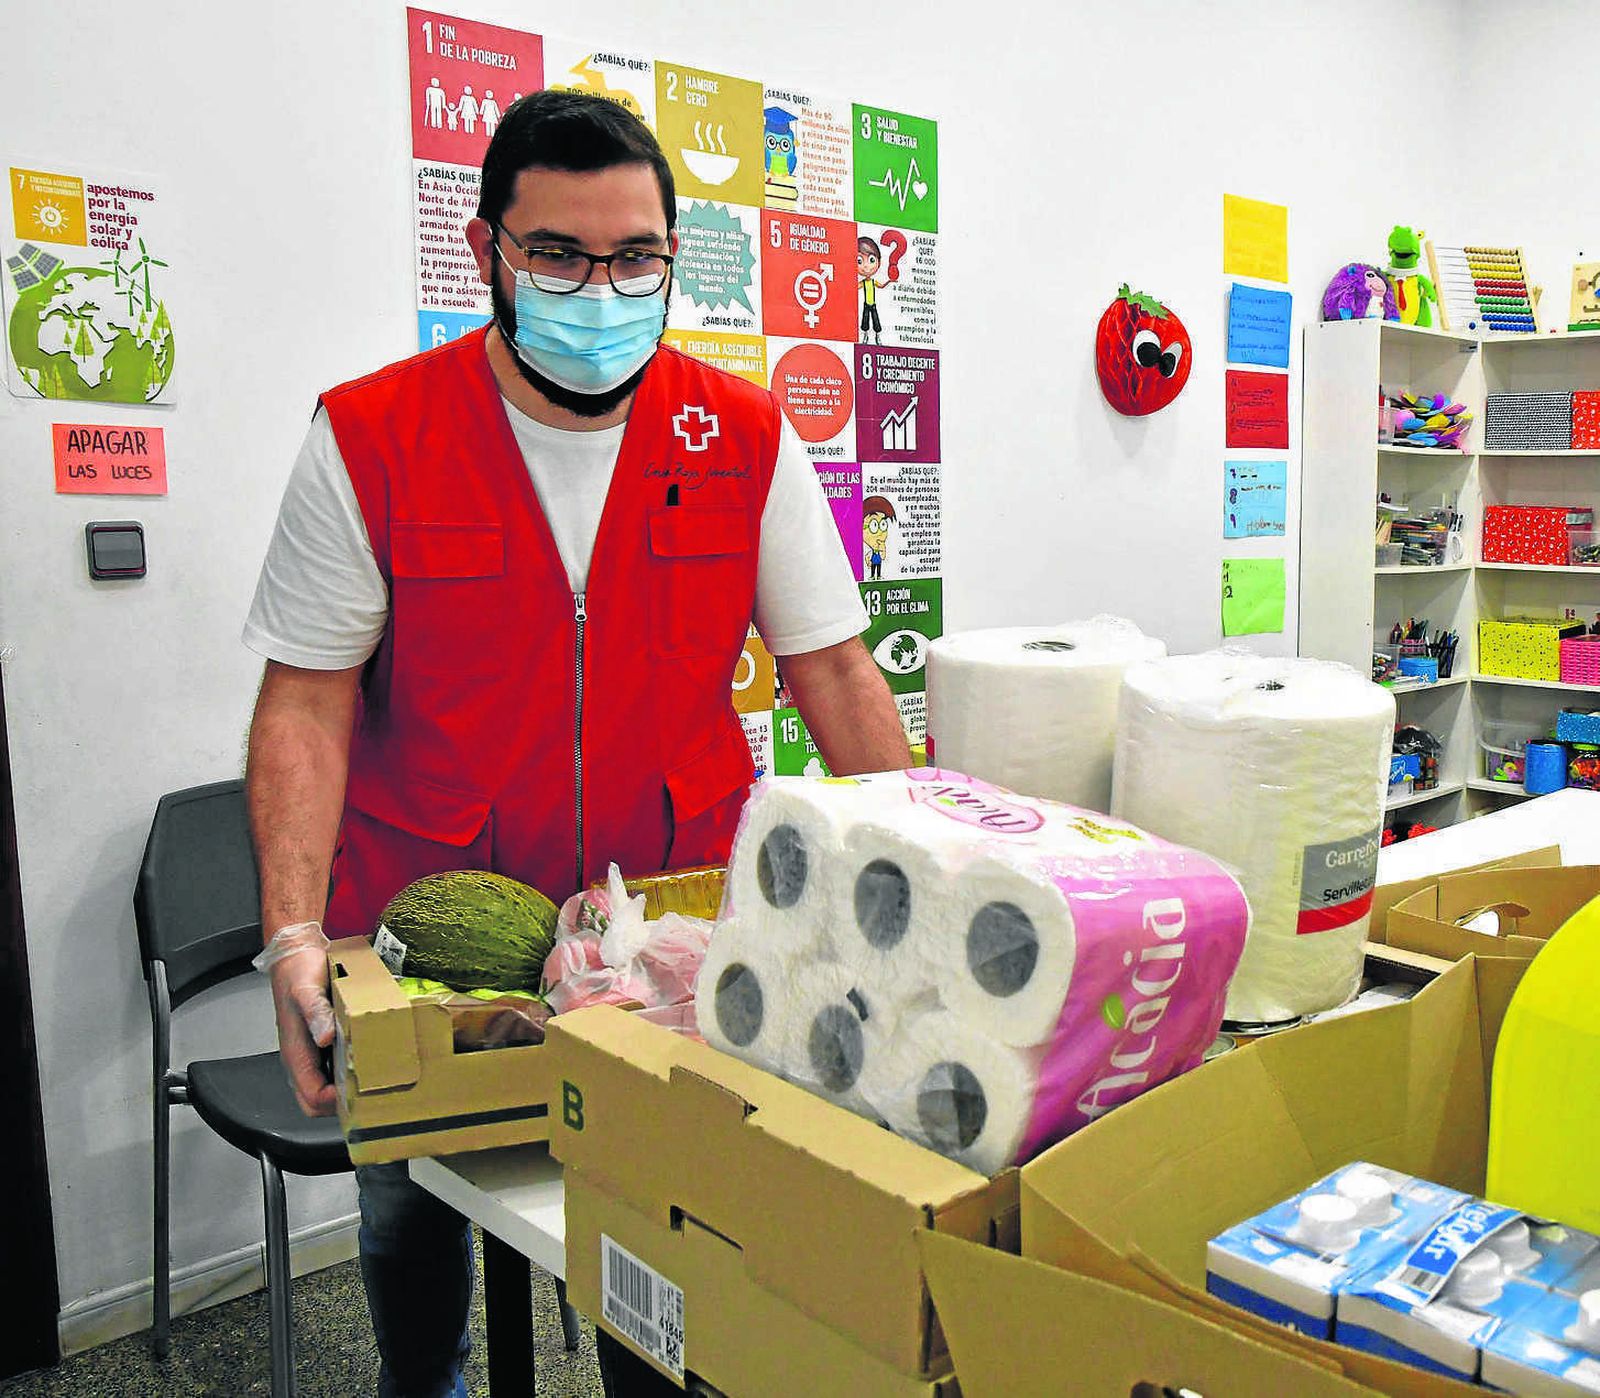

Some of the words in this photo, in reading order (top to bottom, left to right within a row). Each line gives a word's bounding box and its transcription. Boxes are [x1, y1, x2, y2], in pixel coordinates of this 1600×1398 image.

[422, 21, 433, 54] 1
[439, 23, 456, 41] FIN
[440, 41, 454, 57] DE
[456, 44, 469, 61] LA
[472, 47, 517, 71] POBREZA
[666, 71, 678, 102] 2
[685, 74, 719, 94] HAMBRE
[622, 98, 632, 107] de
[686, 91, 707, 107] CERO
[861, 112, 872, 140] 3
[876, 116, 899, 131] SALUD
[877, 129, 882, 141] Y
[883, 131, 918, 149] BIENESTAR
[418, 167, 456, 180] ¿SABÍAS
[17, 174, 25, 190] 7
[418, 180, 430, 190] En
[432, 181, 452, 192] Asia
[455, 184, 480, 196] Occid
[87, 184, 155, 201] apostemos
[418, 192, 445, 204] Norte
[447, 196, 459, 206] de
[88, 198, 110, 209] por
[113, 197, 126, 210] la
[88, 211, 138, 227] energía
[419, 207, 463, 218] conflictos
[89, 223, 122, 236] solar
[125, 229, 133, 241] y
[420, 220, 459, 231] armados
[789, 222, 826, 239] IGUALDAD
[420, 233, 444, 242] curso
[447, 234, 464, 245] han
[770, 220, 782, 248] 5
[90, 236, 129, 250] eólica
[420, 245, 472, 257] aumentado
[789, 238, 800, 250] DE
[801, 239, 829, 254] GÉNERO
[420, 256, 430, 266] la
[421, 270, 433, 279] de
[436, 271, 460, 281] niños
[464, 276, 469, 285] y
[422, 284, 439, 294] que
[442, 285, 453, 294] no
[456, 287, 488, 296] asisten
[430, 295, 439, 305] la
[431, 323, 447, 348] 6
[862, 353, 873, 379] 8
[876, 354, 907, 368] TRABAJO
[908, 357, 935, 370] DECENTE
[876, 367, 881, 379] Y
[883, 368, 925, 381] CRECIMIENTO
[876, 380, 915, 394] ECONÓMICO
[67, 429, 148, 456] APAGAR
[805, 446, 826, 455] ABÍAS
[68, 464, 97, 479] LAS
[111, 464, 152, 480] LUCES
[836, 472, 846, 484] DE
[847, 472, 860, 484] LAS
[905, 485, 913, 493] de
[908, 477, 918, 485] hay
[898, 521, 915, 529] hecho
[911, 529, 932, 539] empleo
[928, 548, 940, 557] para
[909, 565, 915, 573] la
[886, 587, 911, 601] ACCIÓN
[864, 590, 881, 616] 13
[886, 603, 900, 615] POR
[901, 602, 909, 614] EL
[909, 601, 929, 613] CLIMA
[780, 717, 799, 743] 15
[1325, 836, 1379, 868] Carref
[1322, 877, 1374, 902] Serville
[1076, 898, 1187, 1122] Acacia
[562, 1079, 585, 1131] B
